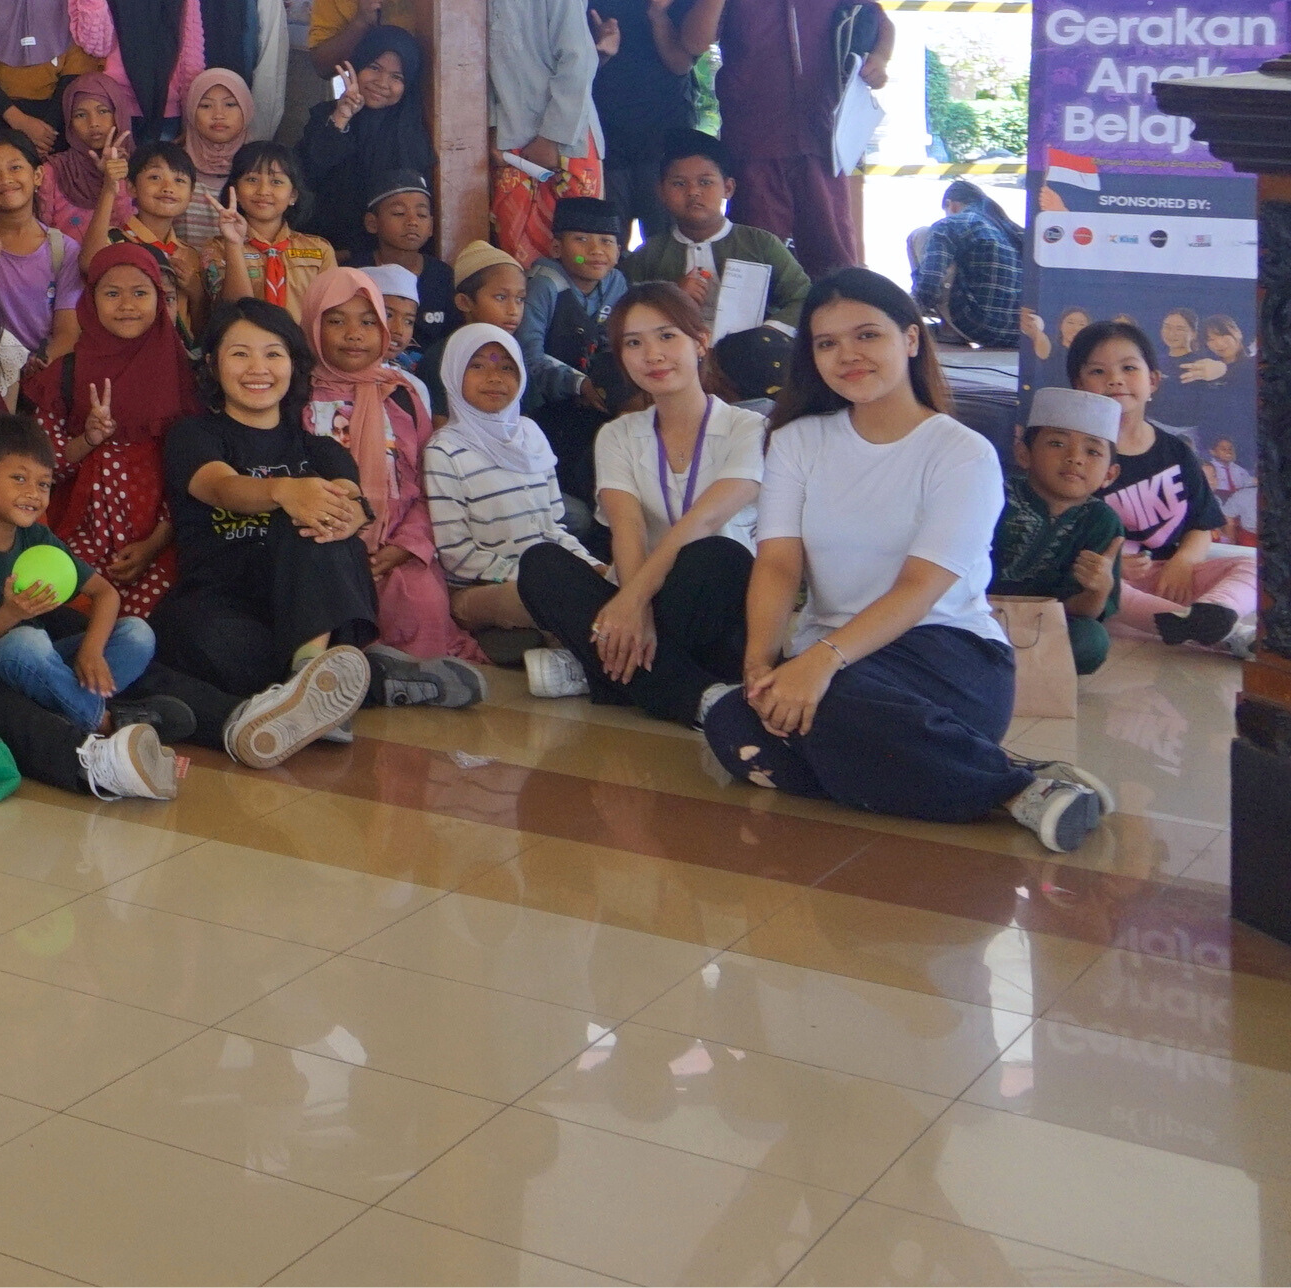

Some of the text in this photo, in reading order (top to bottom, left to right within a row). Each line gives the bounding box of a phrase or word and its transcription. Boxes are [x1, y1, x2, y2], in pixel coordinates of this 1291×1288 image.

[1046, 8, 1276, 45] Gerakan
[1064, 105, 1209, 153] Belaj
[1099, 195, 1211, 210] SPONSORED BY:
[1104, 464, 1188, 532] NIKE
